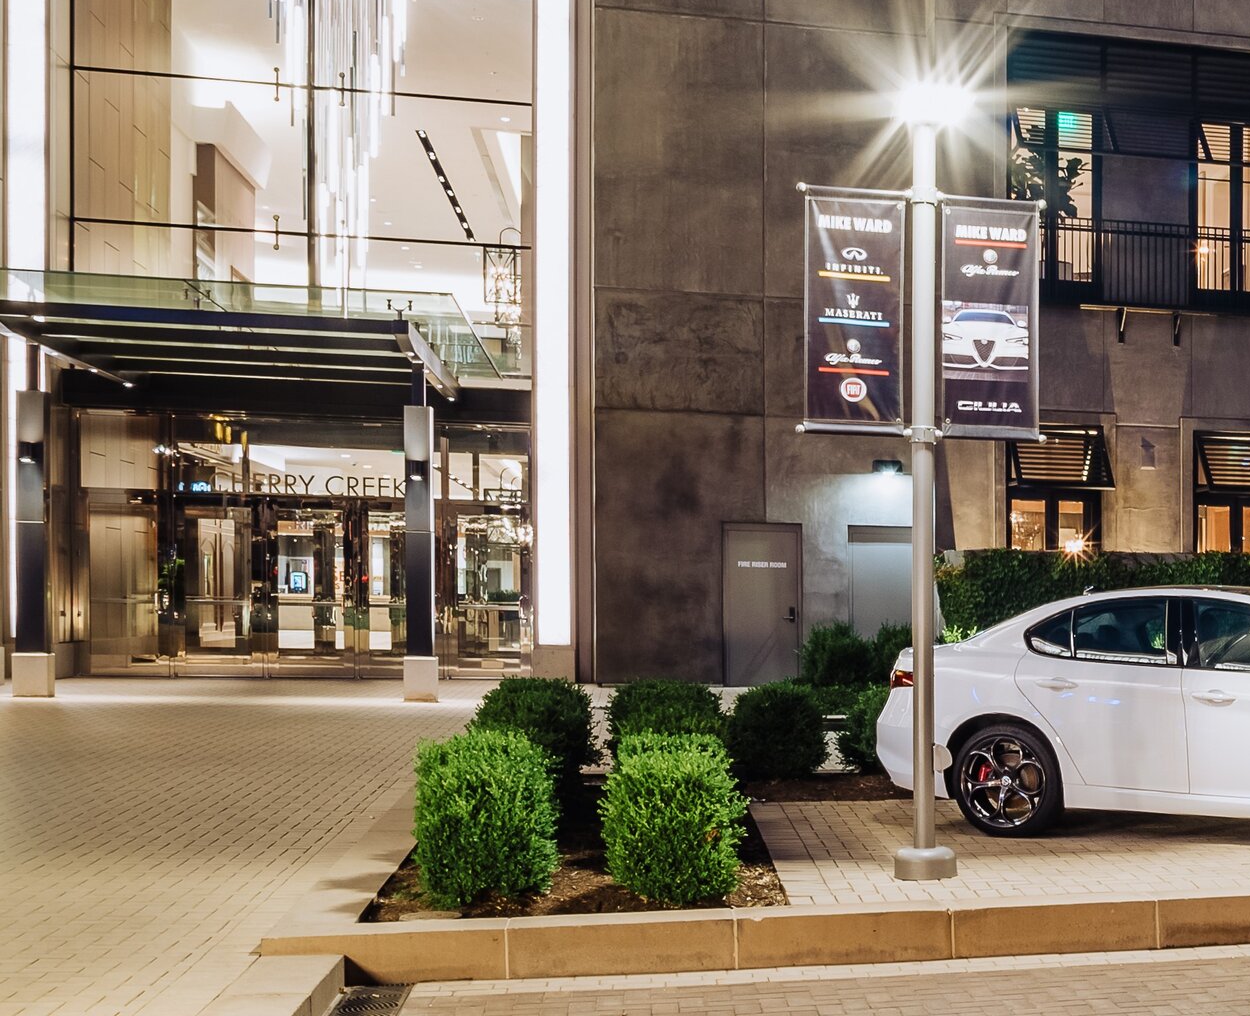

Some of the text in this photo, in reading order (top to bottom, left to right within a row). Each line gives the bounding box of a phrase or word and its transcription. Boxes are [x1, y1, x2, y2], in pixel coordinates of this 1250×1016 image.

[818, 215, 892, 233] MIKE WARD
[956, 225, 1027, 242] MIKE WARD
[960, 264, 1020, 277] Alfa Romeo
[825, 308, 882, 320] MASERATI
[824, 353, 883, 366] Alfa Romeo
[846, 384, 861, 395] FIAT
[211, 471, 316, 496] CHERRY
[325, 475, 405, 498] CREEK
[737, 560, 750, 568] FIRE
[769, 561, 787, 569] ROOM
